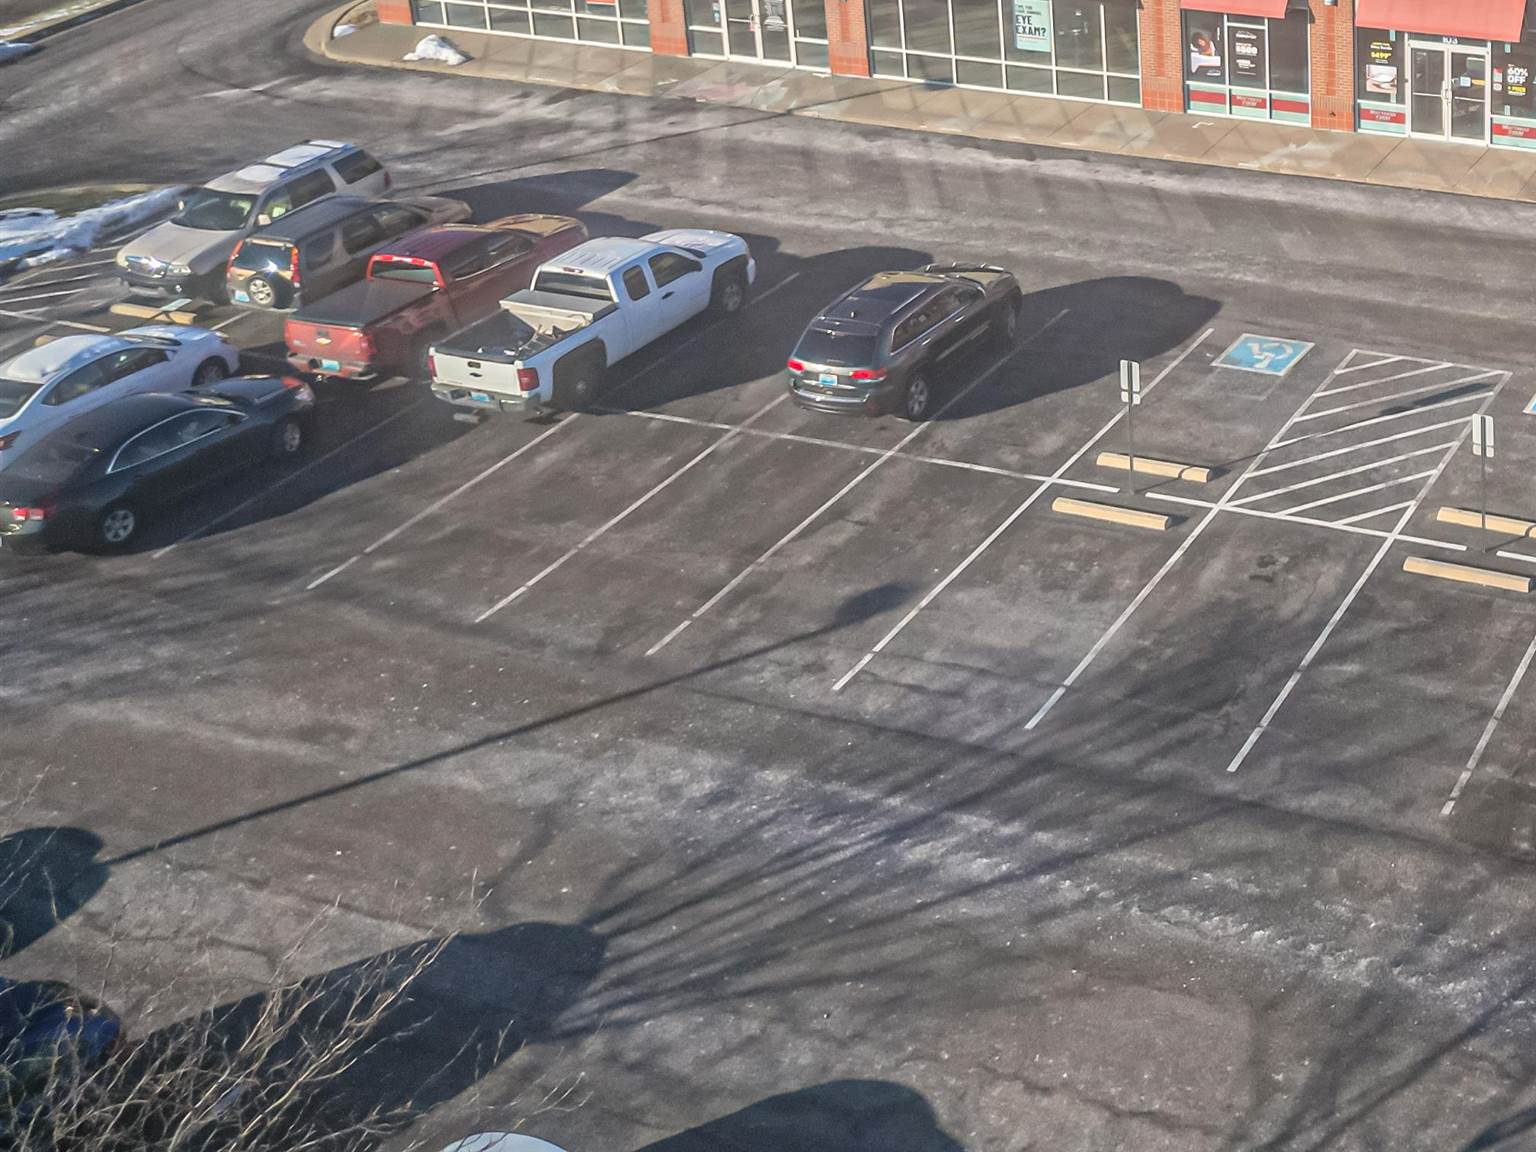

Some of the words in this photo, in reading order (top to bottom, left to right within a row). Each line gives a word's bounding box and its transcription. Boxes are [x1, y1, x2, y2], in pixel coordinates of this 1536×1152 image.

[1015, 14, 1033, 26] EYE
[1015, 25, 1047, 37] EXAM?
[1507, 75, 1526, 84] OFF
